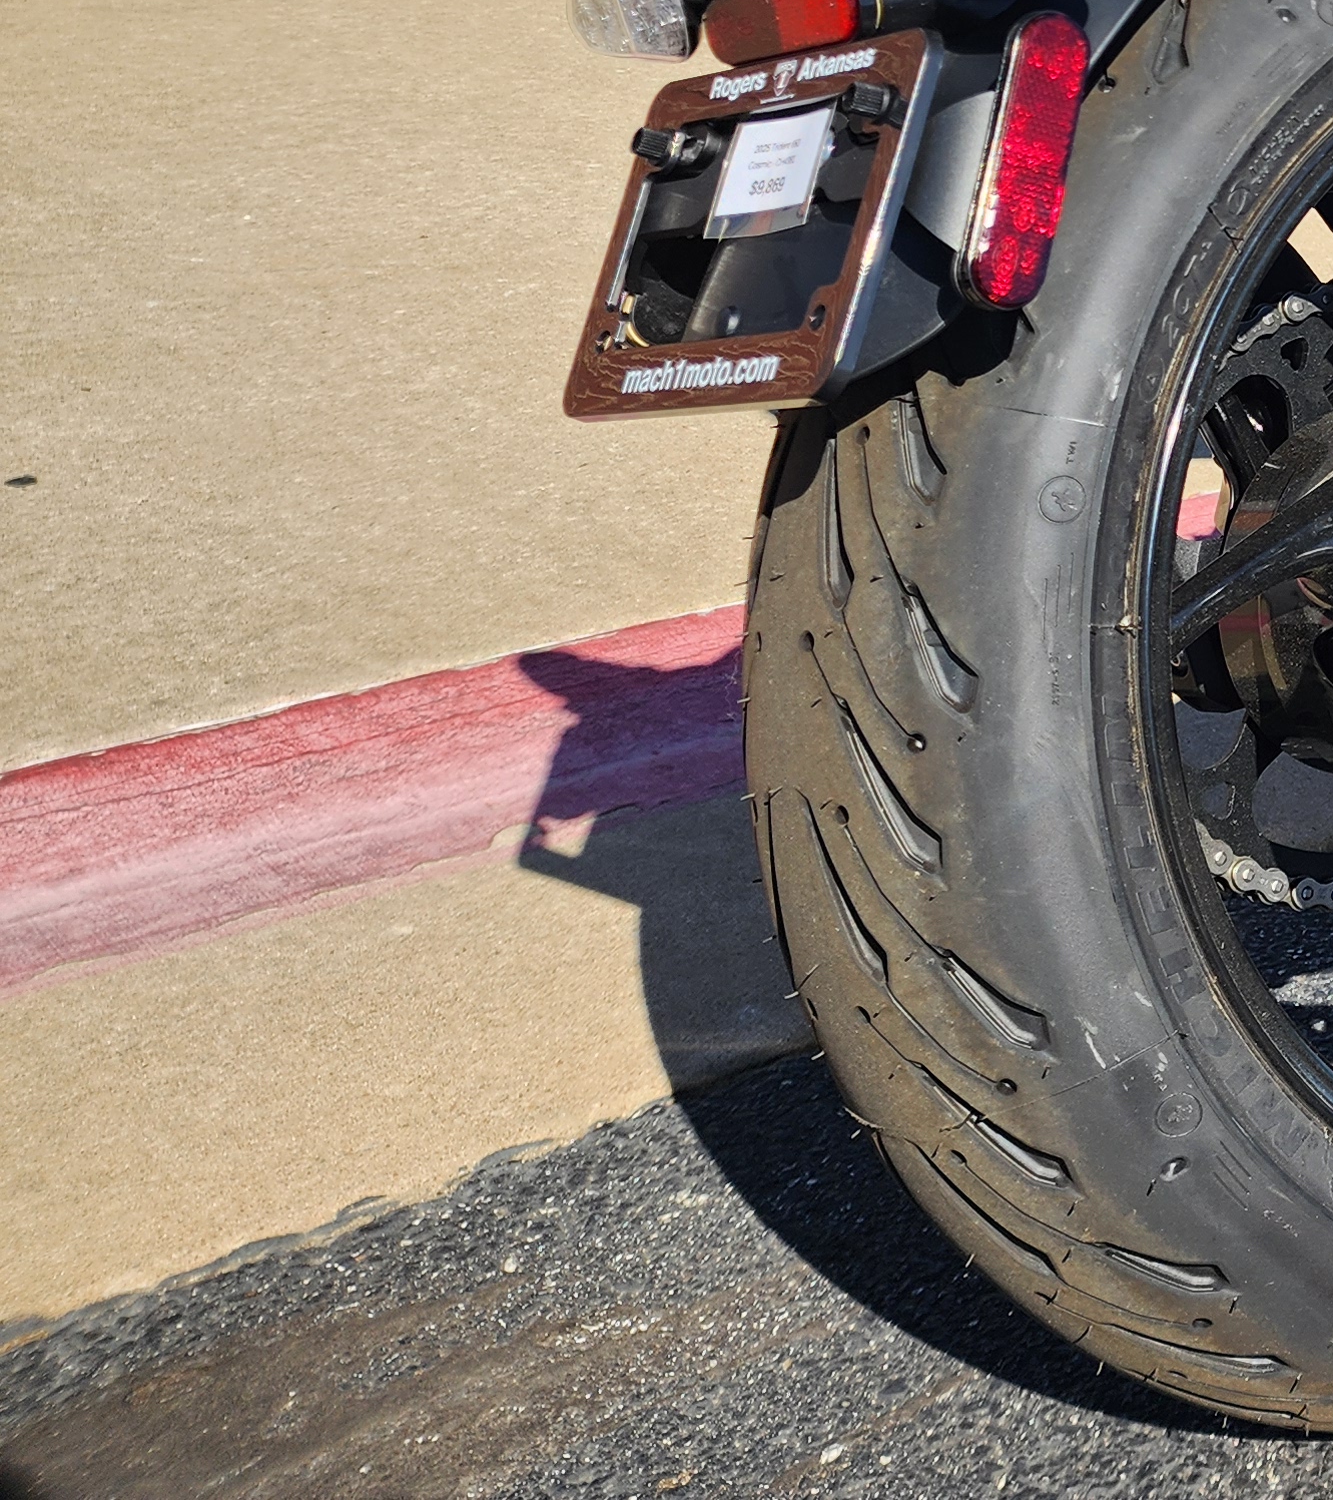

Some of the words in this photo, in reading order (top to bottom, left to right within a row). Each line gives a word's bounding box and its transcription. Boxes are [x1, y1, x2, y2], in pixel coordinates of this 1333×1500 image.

[709, 71, 769, 101] Rogers
[796, 47, 879, 82] Arkansas
[748, 176, 786, 197] $9,869
[621, 354, 781, 395] mach1moto.com
